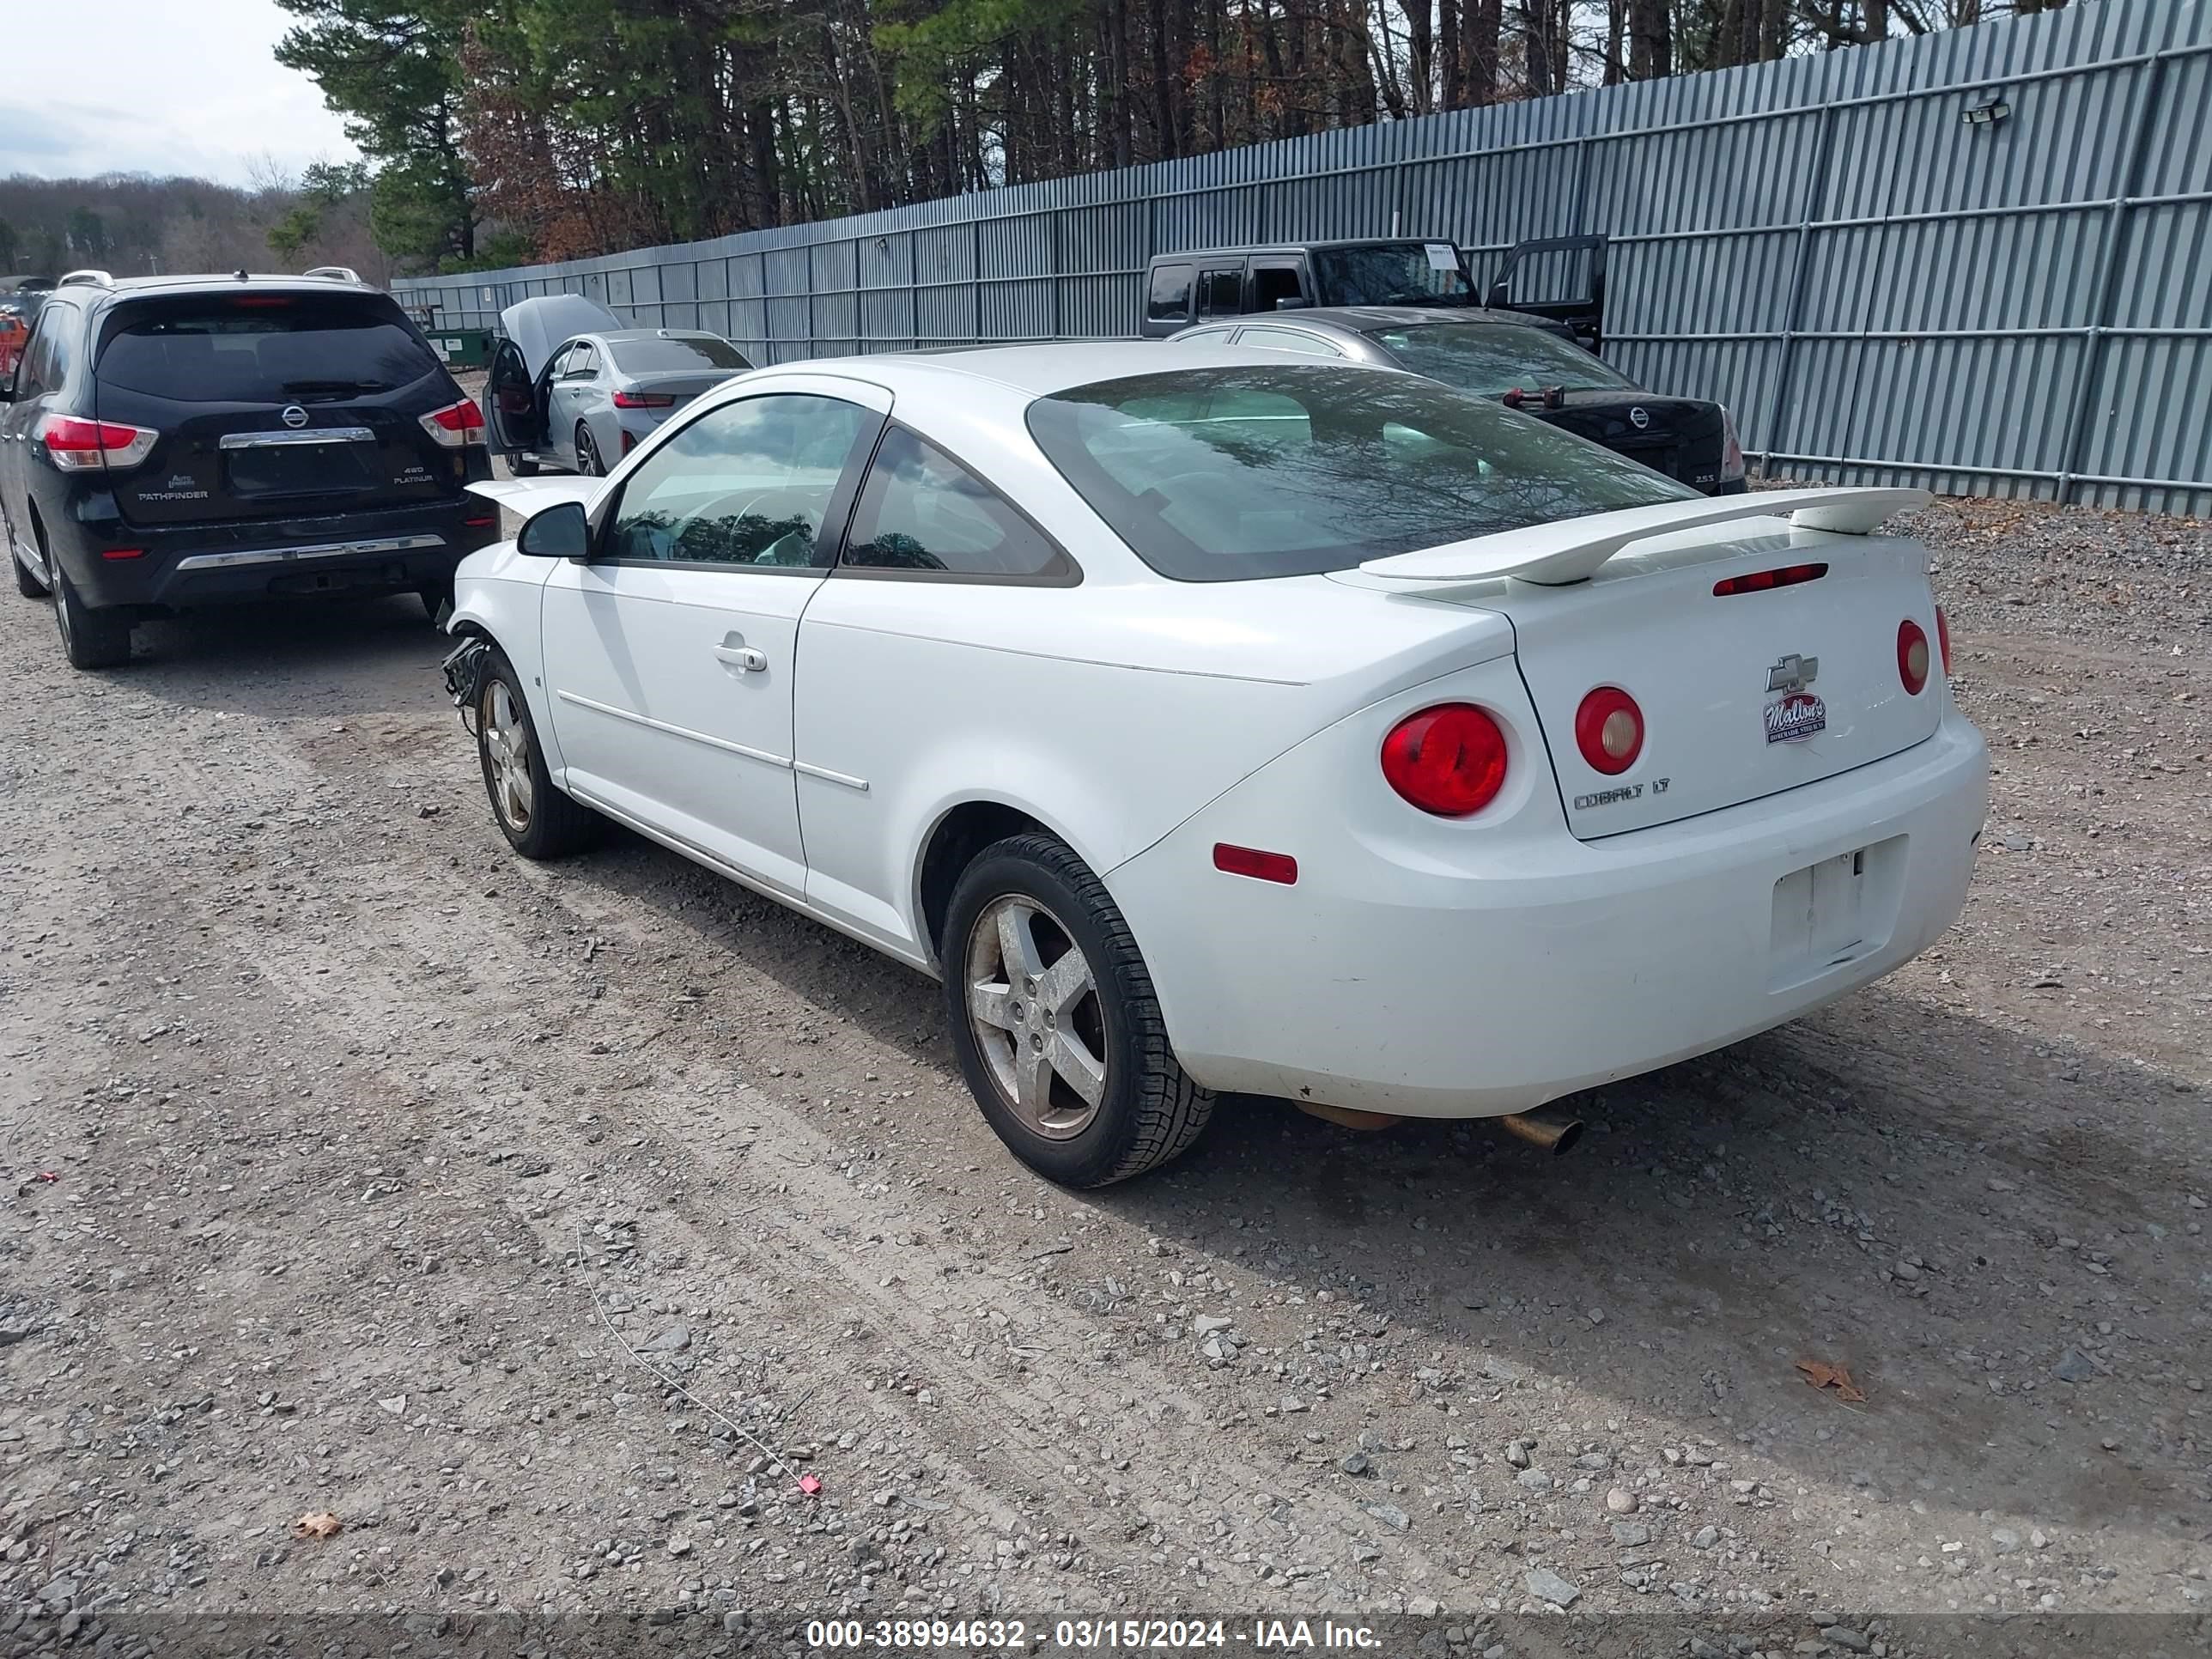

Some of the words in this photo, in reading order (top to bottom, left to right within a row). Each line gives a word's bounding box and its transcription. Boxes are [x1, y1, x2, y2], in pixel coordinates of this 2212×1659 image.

[393, 475, 434, 485] PLATINUM
[137, 490, 209, 501] PATHFINDER
[1765, 698, 1825, 730] Mallon's
[1574, 783, 1644, 810] COBALT
[1652, 777, 1671, 794] LT
